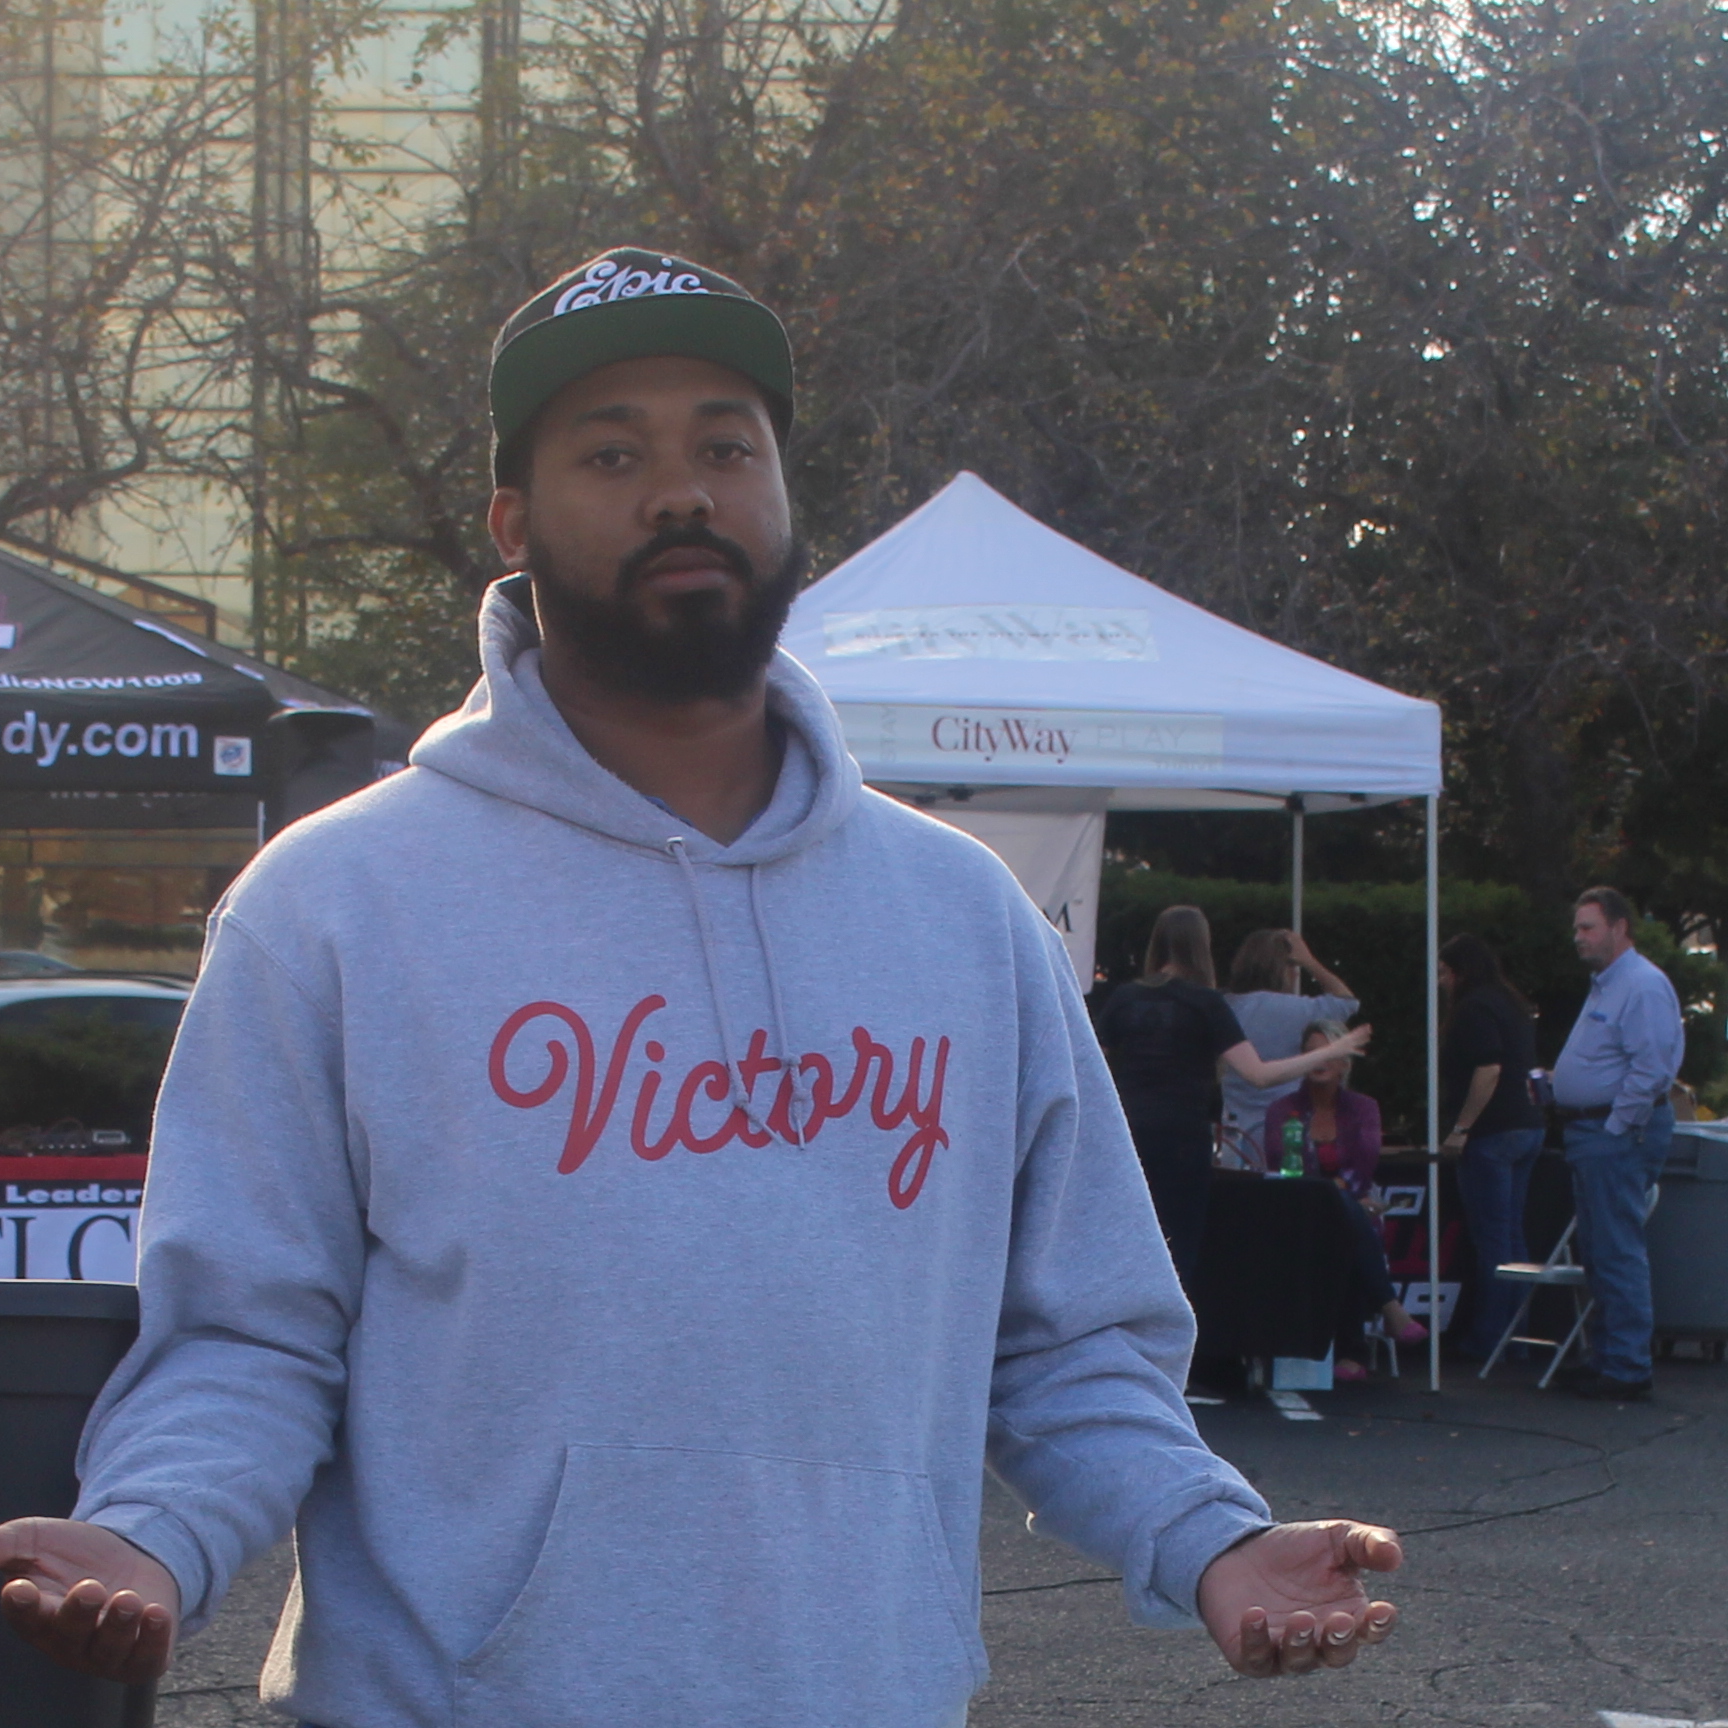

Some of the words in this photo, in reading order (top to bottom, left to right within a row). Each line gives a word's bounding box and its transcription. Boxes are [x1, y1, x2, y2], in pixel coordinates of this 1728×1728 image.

[554, 258, 709, 316] Epic
[931, 714, 1077, 764] CityWay
[488, 994, 950, 1210] Victory
